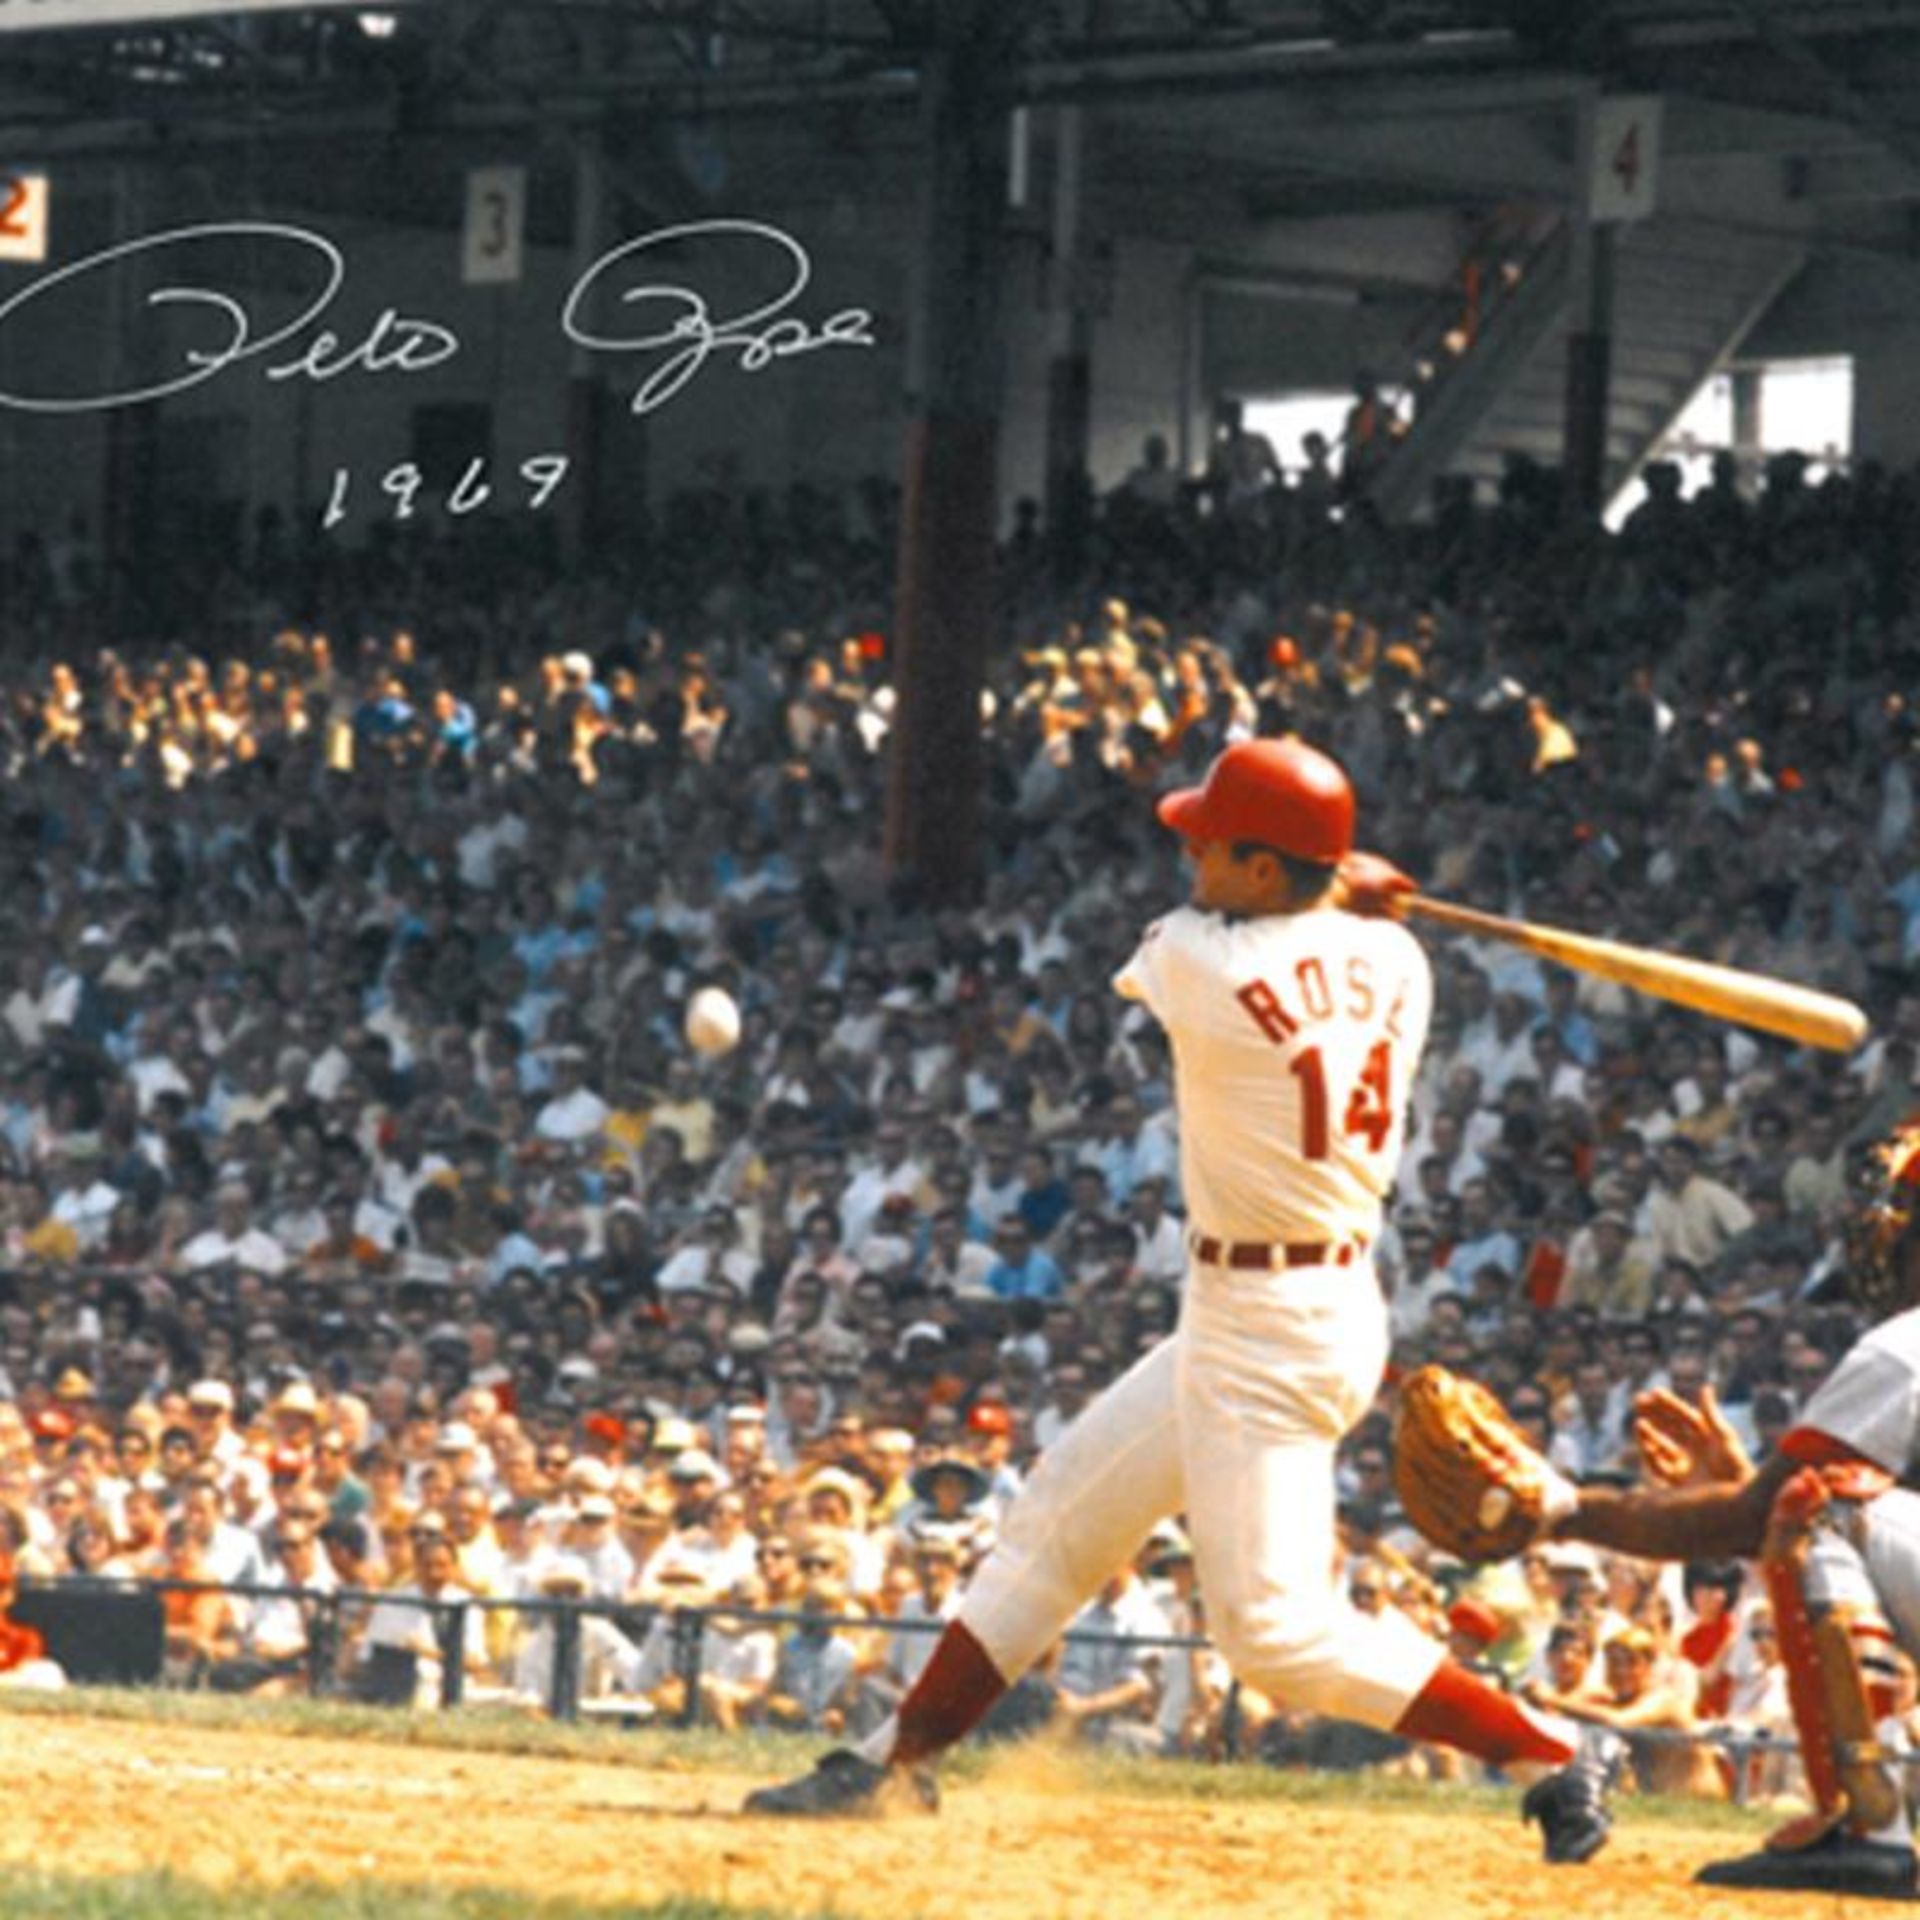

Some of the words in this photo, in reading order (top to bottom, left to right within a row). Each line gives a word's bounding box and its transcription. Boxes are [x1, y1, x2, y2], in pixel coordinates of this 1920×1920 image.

[1612, 119, 1640, 193] 4
[481, 190, 508, 258] 3
[1290, 1040, 1391, 1160] 14
